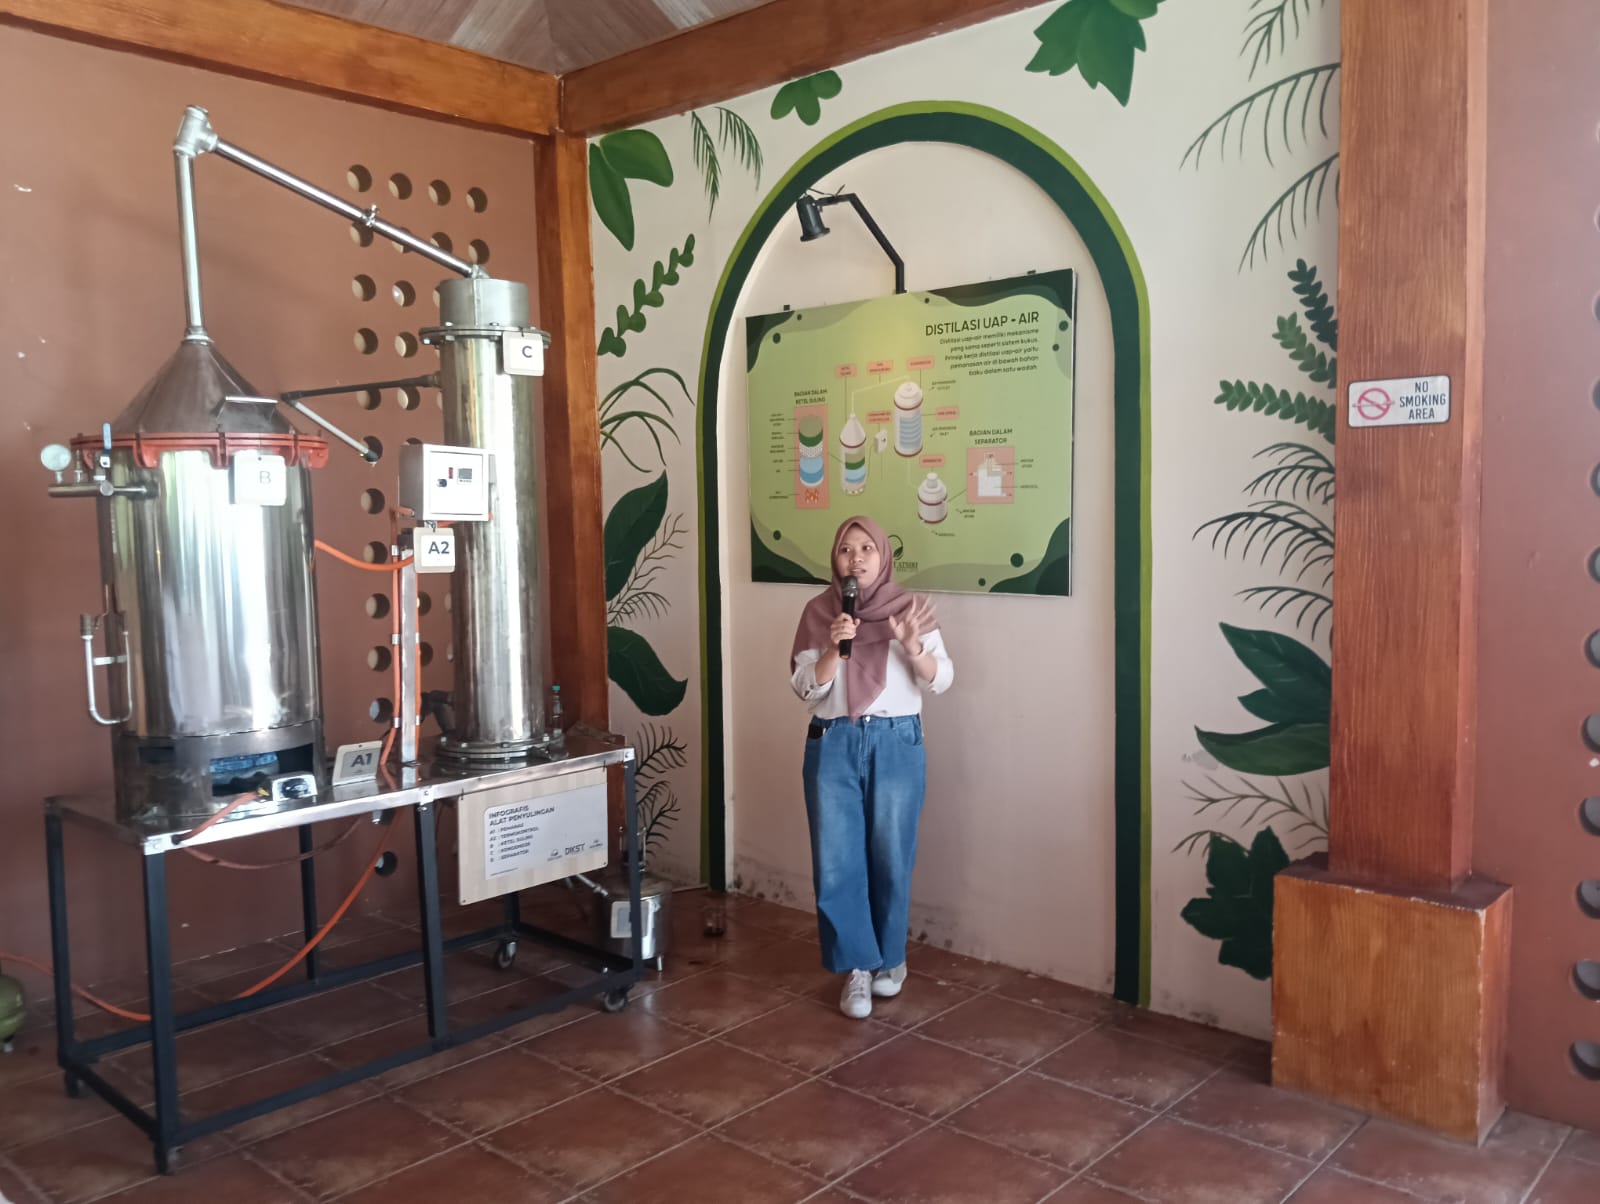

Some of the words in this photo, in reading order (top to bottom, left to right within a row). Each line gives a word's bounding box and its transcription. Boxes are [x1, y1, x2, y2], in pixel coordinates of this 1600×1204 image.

[926, 318, 980, 336] DISTILASI
[983, 315, 1008, 329] UAP
[1018, 312, 1040, 325] AIR
[522, 345, 532, 358] C
[1414, 380, 1428, 393] NO
[1400, 394, 1446, 408] SMOKING
[1408, 408, 1435, 420] AREA
[974, 437, 1008, 445] SEPARATOR
[260, 470, 271, 484] B
[428, 540, 450, 554] A2
[350, 752, 372, 768] A1
[488, 805, 529, 819] INFOGRAFIS
[489, 818, 507, 826] ALAT
[508, 806, 555, 822] PENYULINGAN
